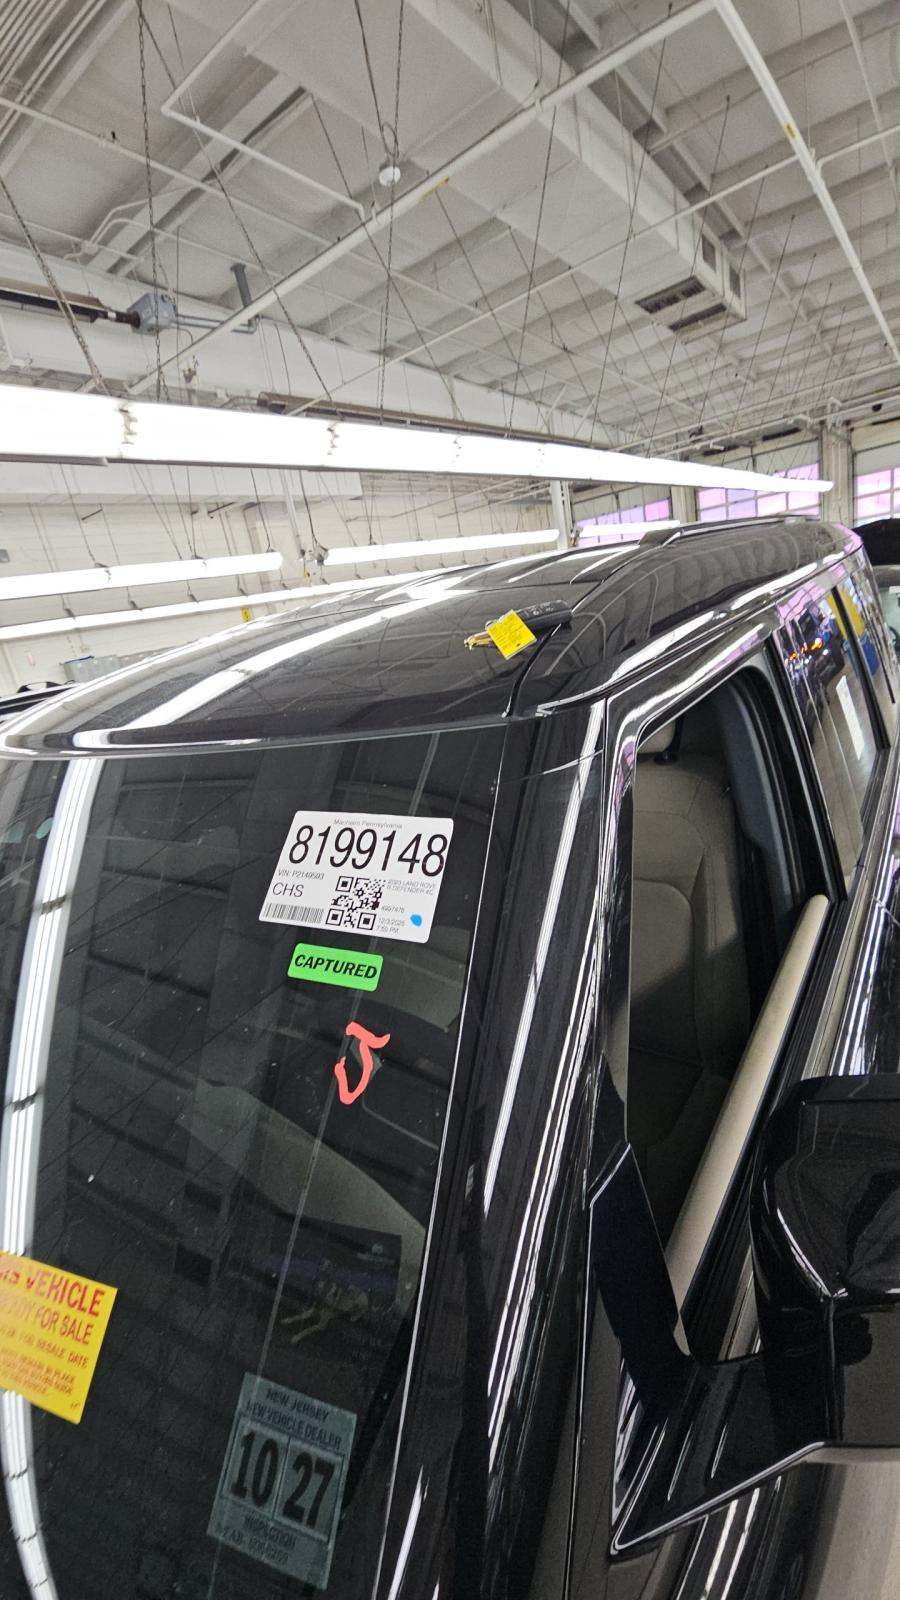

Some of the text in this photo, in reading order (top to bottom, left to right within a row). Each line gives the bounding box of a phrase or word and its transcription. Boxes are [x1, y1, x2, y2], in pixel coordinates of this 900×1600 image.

[289, 824, 448, 877] 8199148
[272, 882, 304, 898] CHS
[294, 954, 378, 979] CAPTURED
[26, 1265, 105, 1317] VEHICLE
[35, 1305, 60, 1333] FOR
[60, 1315, 93, 1345] SALE
[265, 1388, 330, 1423] NEW JERSEY
[230, 1431, 336, 1529] 10 27
